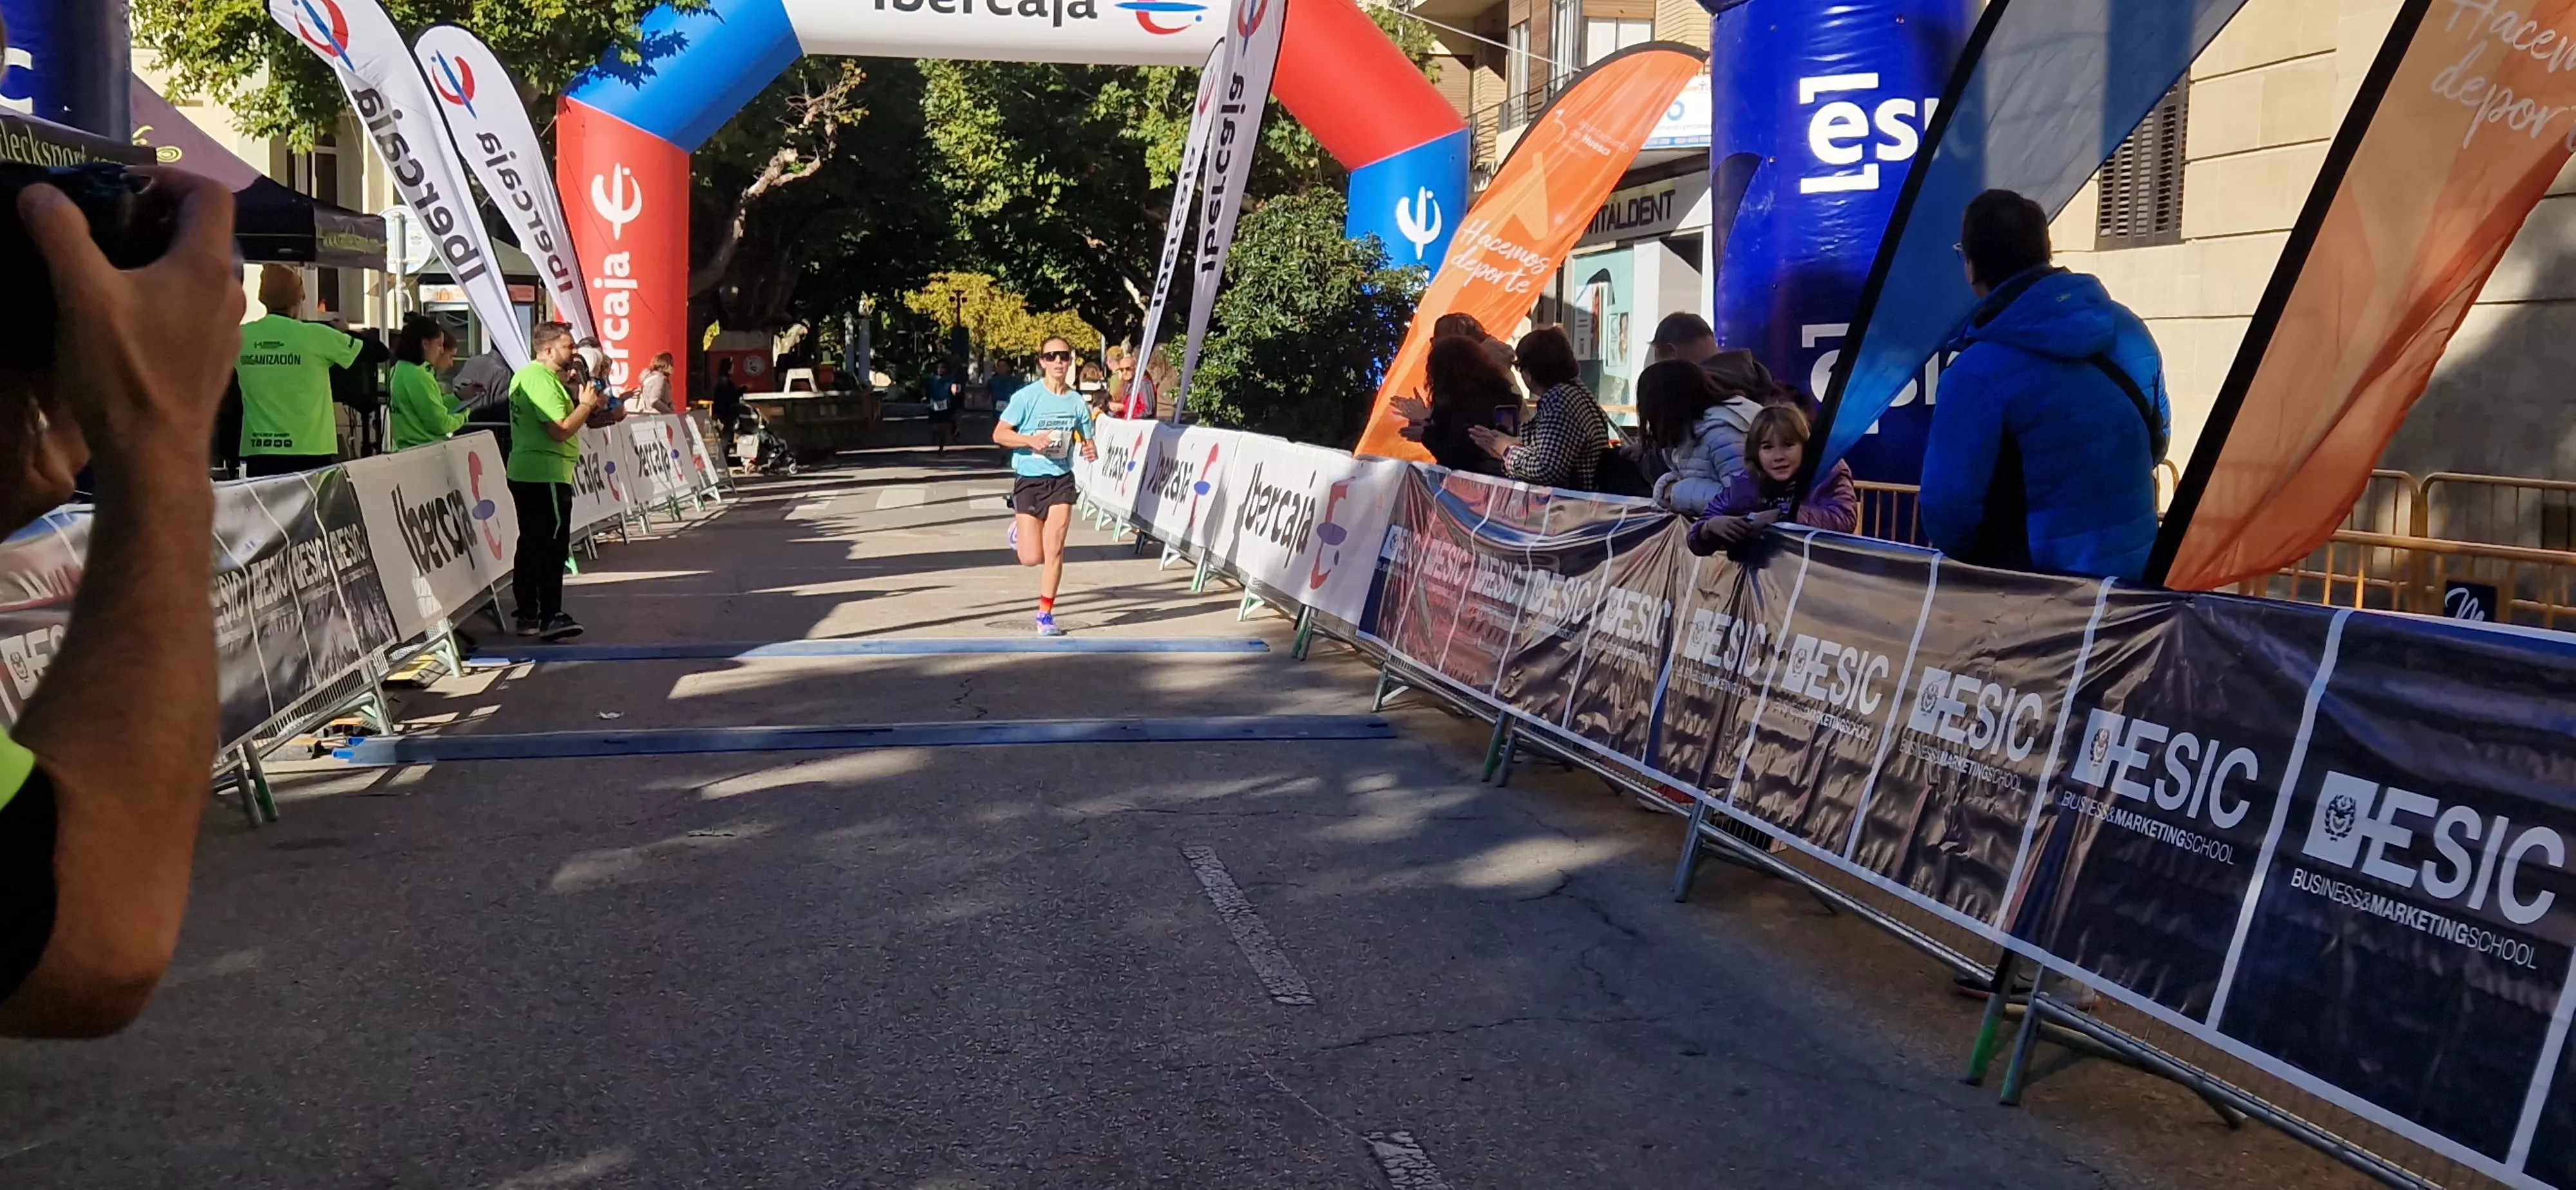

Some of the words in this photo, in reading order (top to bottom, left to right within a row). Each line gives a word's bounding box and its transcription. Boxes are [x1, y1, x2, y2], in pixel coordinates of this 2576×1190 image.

[875, 0, 1098, 27] ecaja
[1808, 97, 1940, 165] es
[1450, 246, 1531, 294] deporte
[1463, 218, 1551, 276] Hacemos
[593, 251, 638, 397] ercaja
[1244, 460, 1316, 569] Ibercaja
[1702, 611, 1767, 677] ESIC
[1804, 639, 1890, 715] ESIC
[1937, 674, 2043, 762] ESIC
[2110, 717, 2259, 829] ESIC
[2060, 791, 2235, 866] BUSESS&MARKETINGSCHOOL
[2361, 786, 2566, 925] ESIC
[2290, 867, 2538, 970] BUSINESS&MARKETINGSCHOOL
